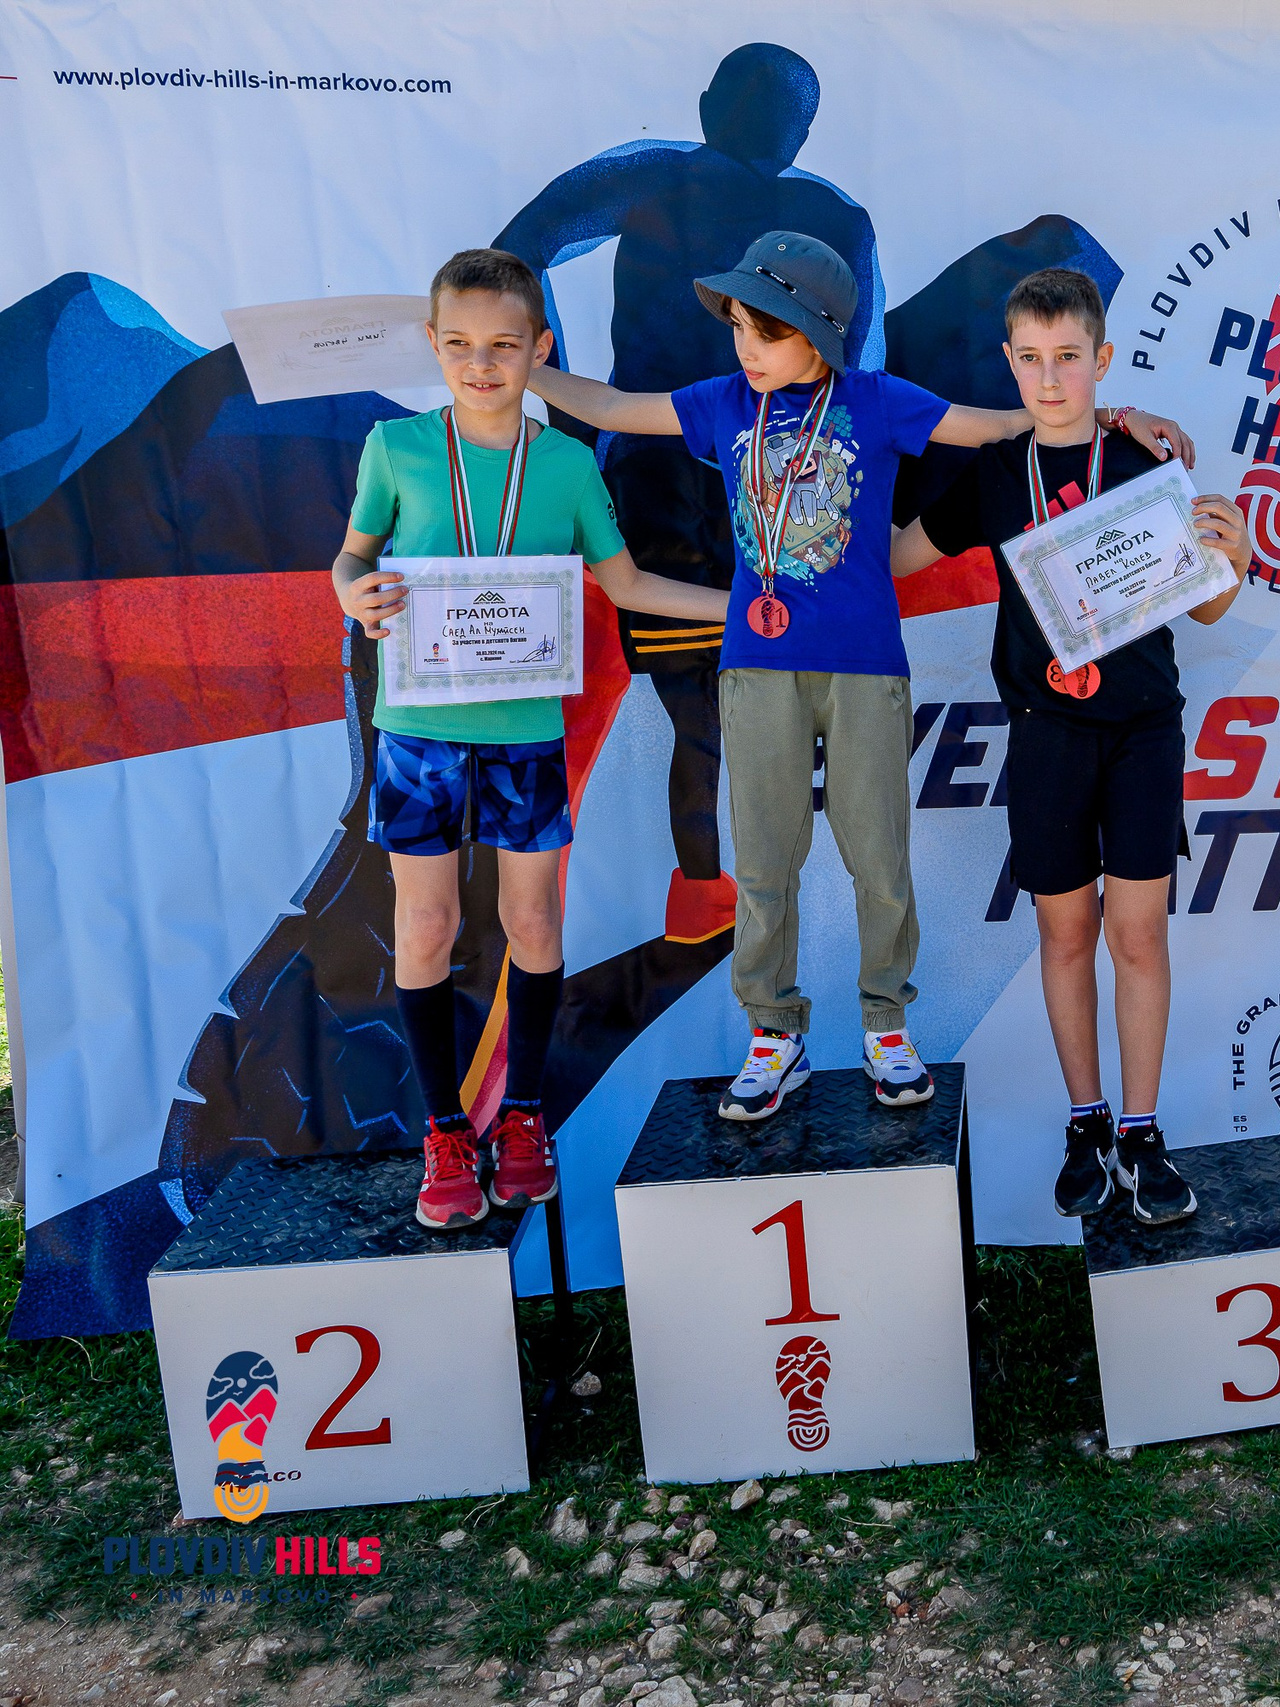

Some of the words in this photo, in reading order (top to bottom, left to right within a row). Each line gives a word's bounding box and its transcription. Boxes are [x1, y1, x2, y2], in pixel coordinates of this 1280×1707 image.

[53, 67, 453, 95] www.plovdiv-hills-in-markovo.com
[1131, 210, 1250, 371] PLOVDIV
[1075, 530, 1155, 575] ГРАМОТА
[446, 606, 530, 620] ГРАМОТА
[1231, 1043, 1246, 1091] THE
[1233, 1114, 1247, 1123] ES
[1233, 1125, 1248, 1133] TD
[752, 1200, 840, 1326] 1
[294, 1324, 392, 1451] 2
